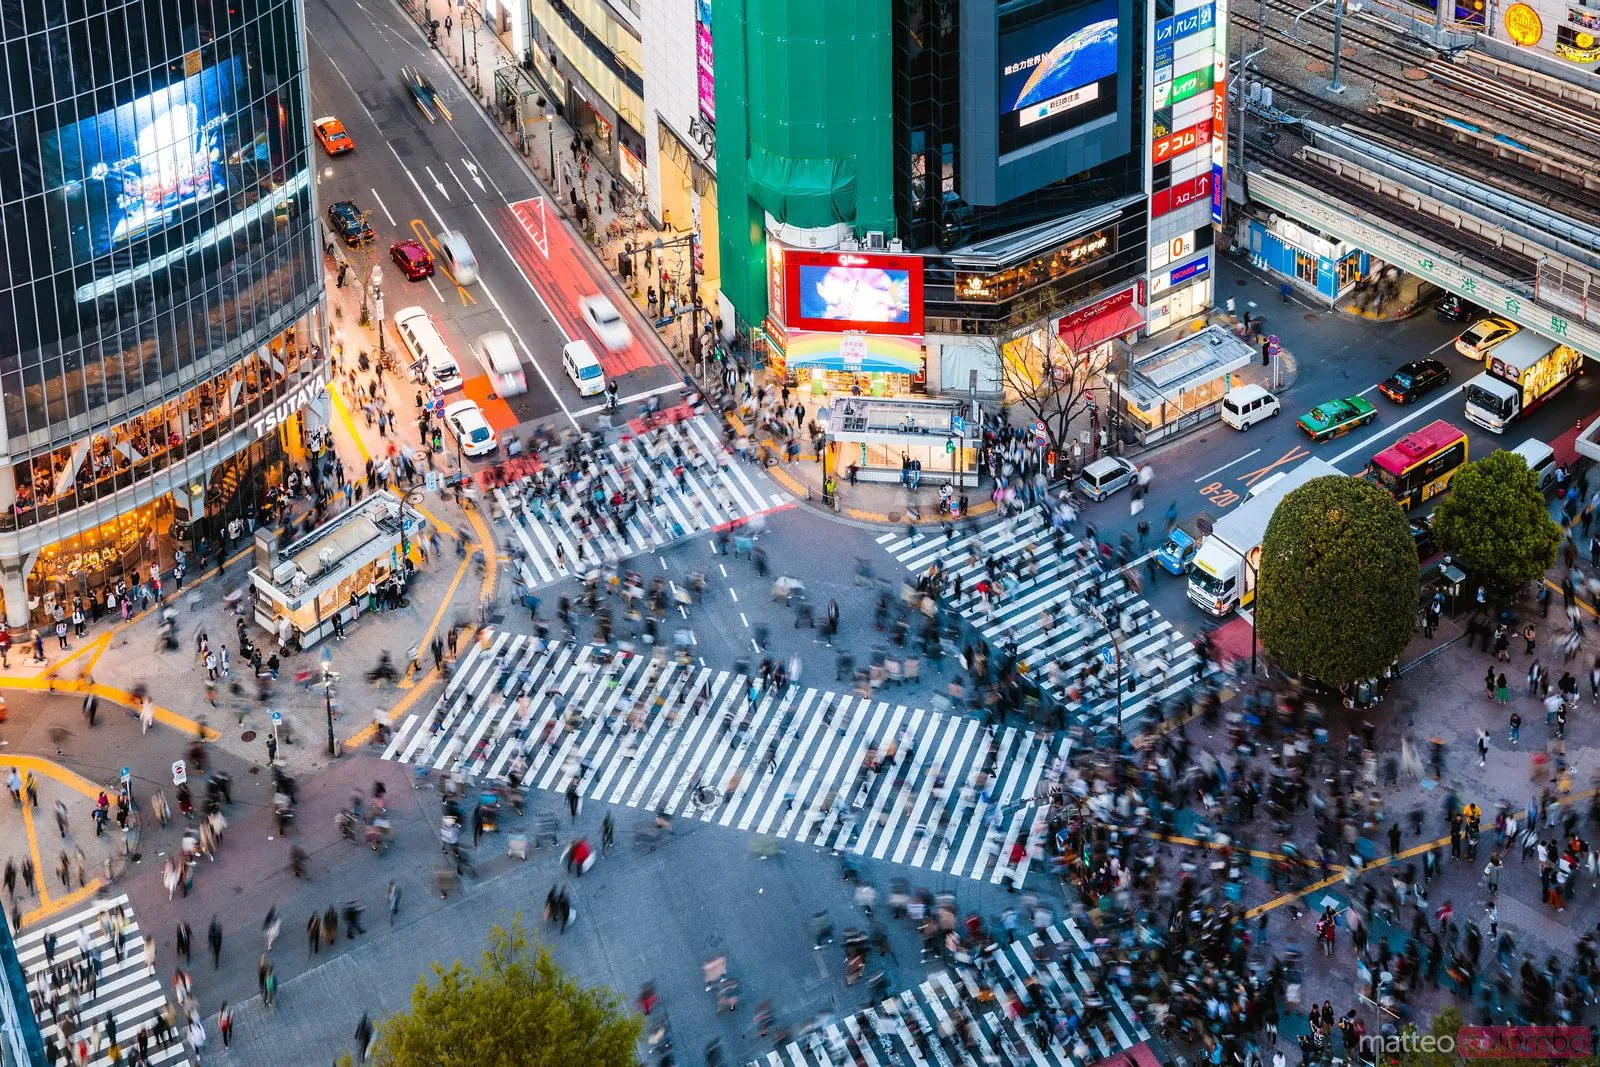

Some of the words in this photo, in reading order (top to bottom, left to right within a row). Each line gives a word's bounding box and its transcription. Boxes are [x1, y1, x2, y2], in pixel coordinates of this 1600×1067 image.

[1510, 11, 1538, 30] Public
[1173, 77, 1195, 96] レイク
[1158, 132, 1195, 157] アコム
[1176, 193, 1190, 205] 入口
[1172, 237, 1190, 257] 0円
[1418, 258, 1434, 271] JR
[254, 375, 326, 438] TSUTAYA
[1200, 481, 1240, 508] 8-20
